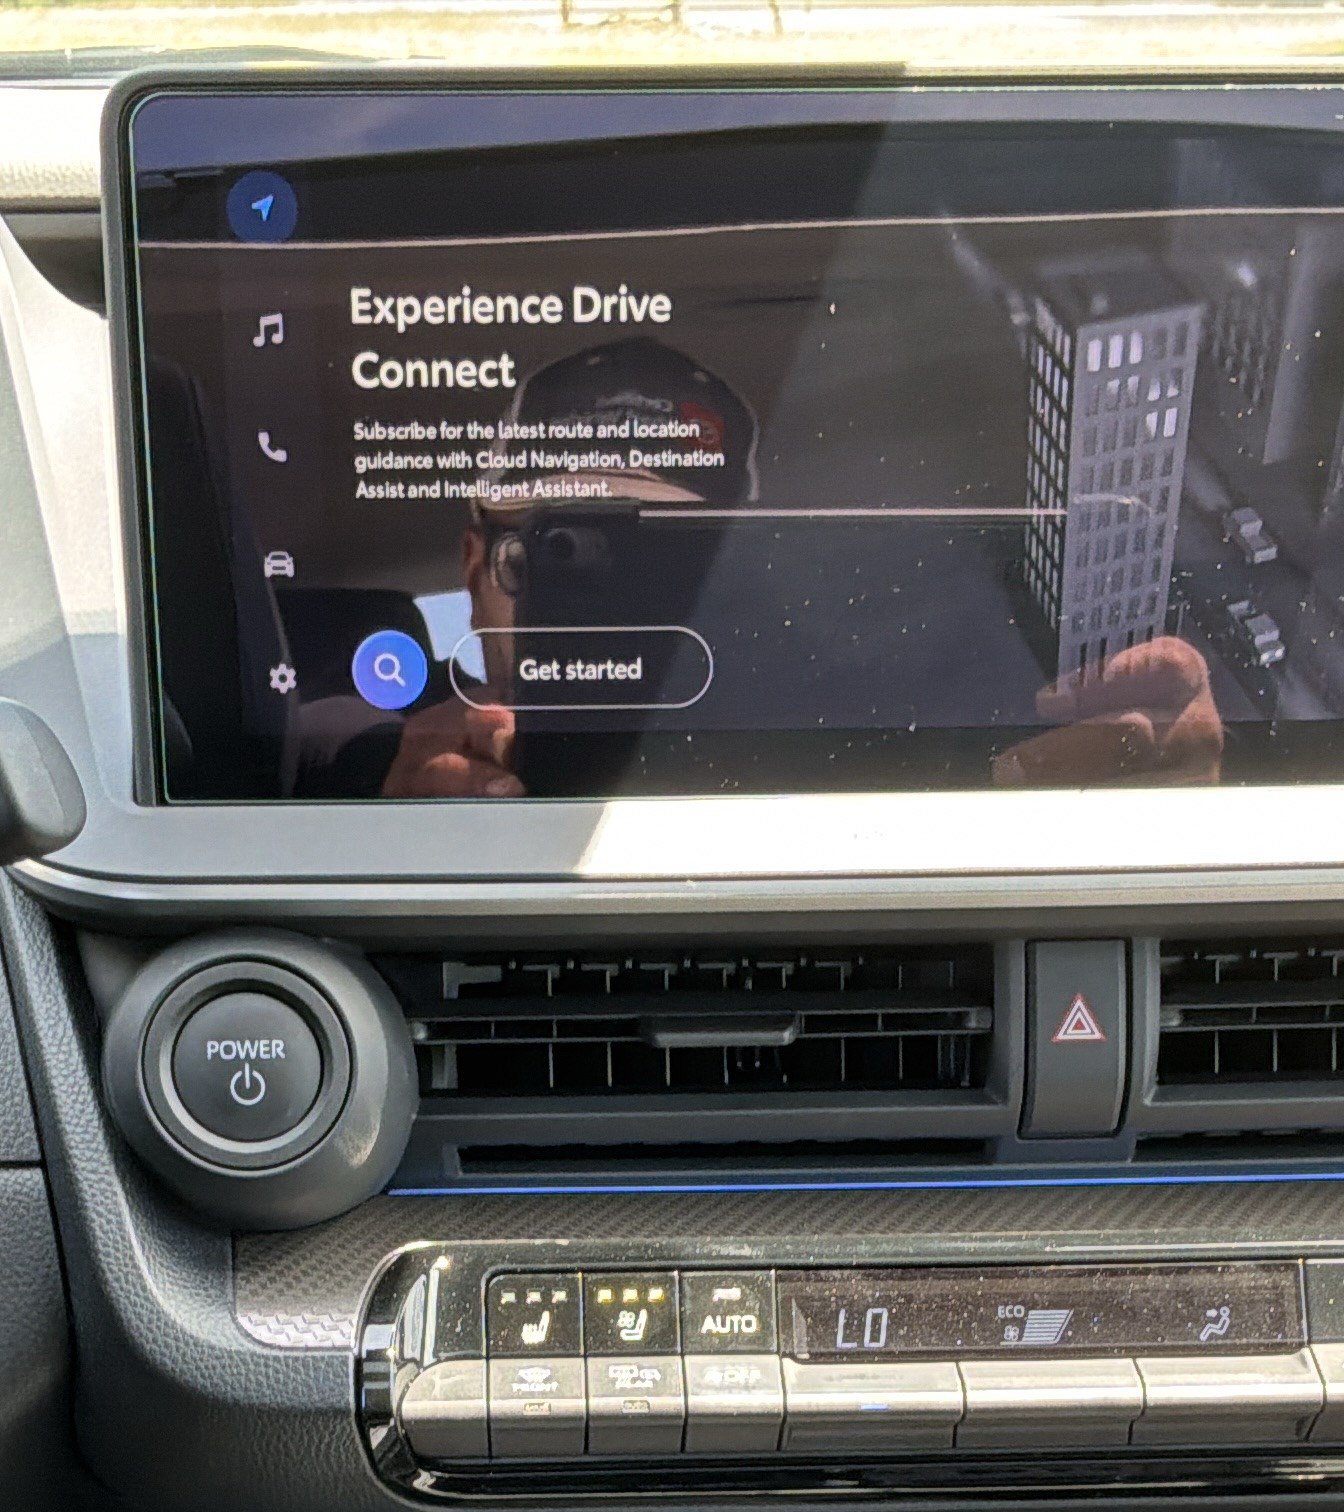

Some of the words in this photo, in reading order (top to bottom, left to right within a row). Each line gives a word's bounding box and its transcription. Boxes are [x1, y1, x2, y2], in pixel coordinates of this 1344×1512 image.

[350, 284, 564, 333] Experience
[572, 283, 672, 324] Drive
[351, 351, 517, 389] Connect
[353, 421, 437, 440] Subscribe
[440, 420, 464, 440] for
[467, 420, 495, 440] the
[498, 419, 546, 440] latest
[548, 423, 594, 439] route
[596, 419, 630, 439] and
[633, 418, 700, 439] location
[354, 450, 434, 474] guidance
[436, 450, 473, 469] with
[475, 450, 528, 469] Cloud
[530, 450, 626, 472] Navigation,
[629, 449, 725, 468] Destination
[355, 479, 405, 499] Assist
[407, 479, 441, 499] and
[444, 479, 530, 502] Intelligent
[532, 479, 613, 498] Assistant.
[519, 658, 562, 680] Get
[565, 656, 642, 680] started
[206, 1039, 286, 1060] POWER
[997, 1304, 1026, 1319] ECO
[700, 1314, 758, 1335] AUTO
[836, 1307, 889, 1348] LO
